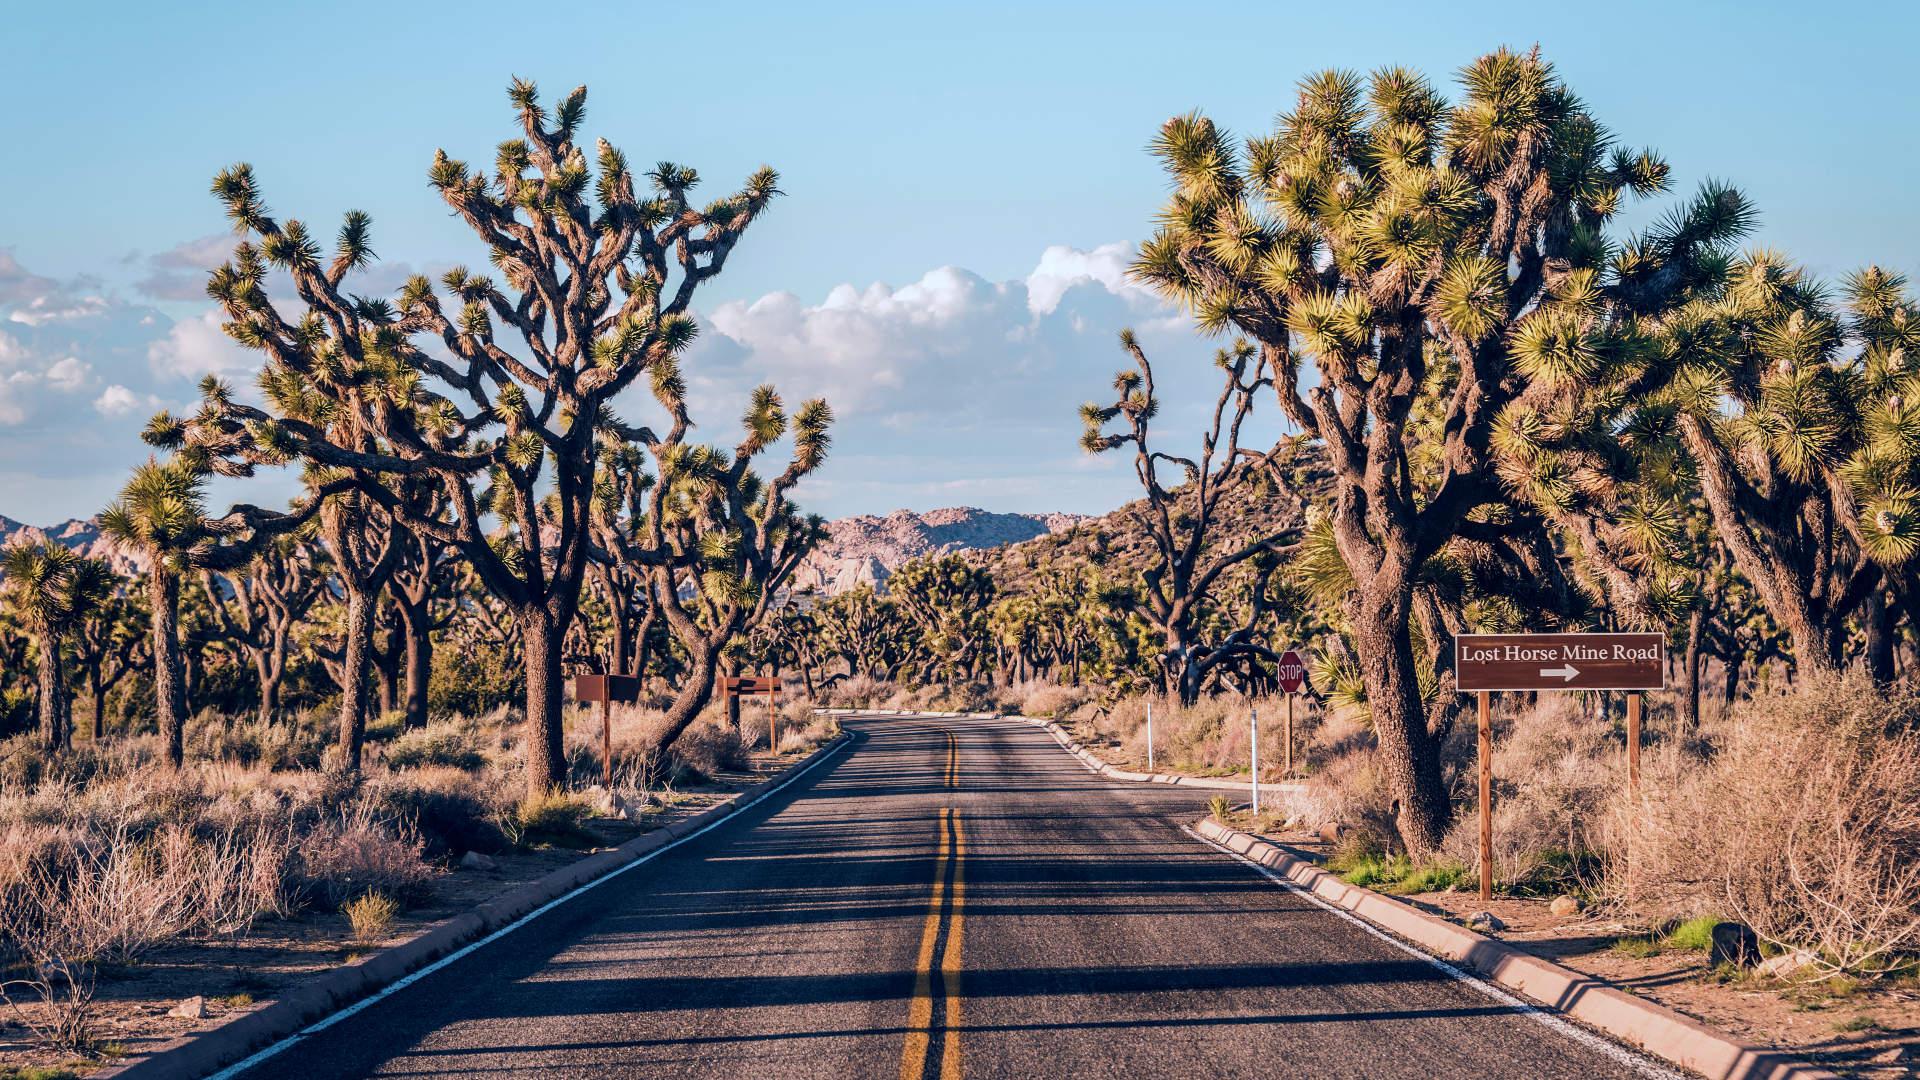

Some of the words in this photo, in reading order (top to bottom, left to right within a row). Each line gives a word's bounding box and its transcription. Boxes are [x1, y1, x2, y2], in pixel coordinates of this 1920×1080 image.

[1461, 646, 1500, 661] Lost
[1504, 645, 1558, 661] Horse
[1562, 645, 1608, 660] Mine
[1612, 644, 1658, 660] Road
[1280, 664, 1302, 680] STOP
